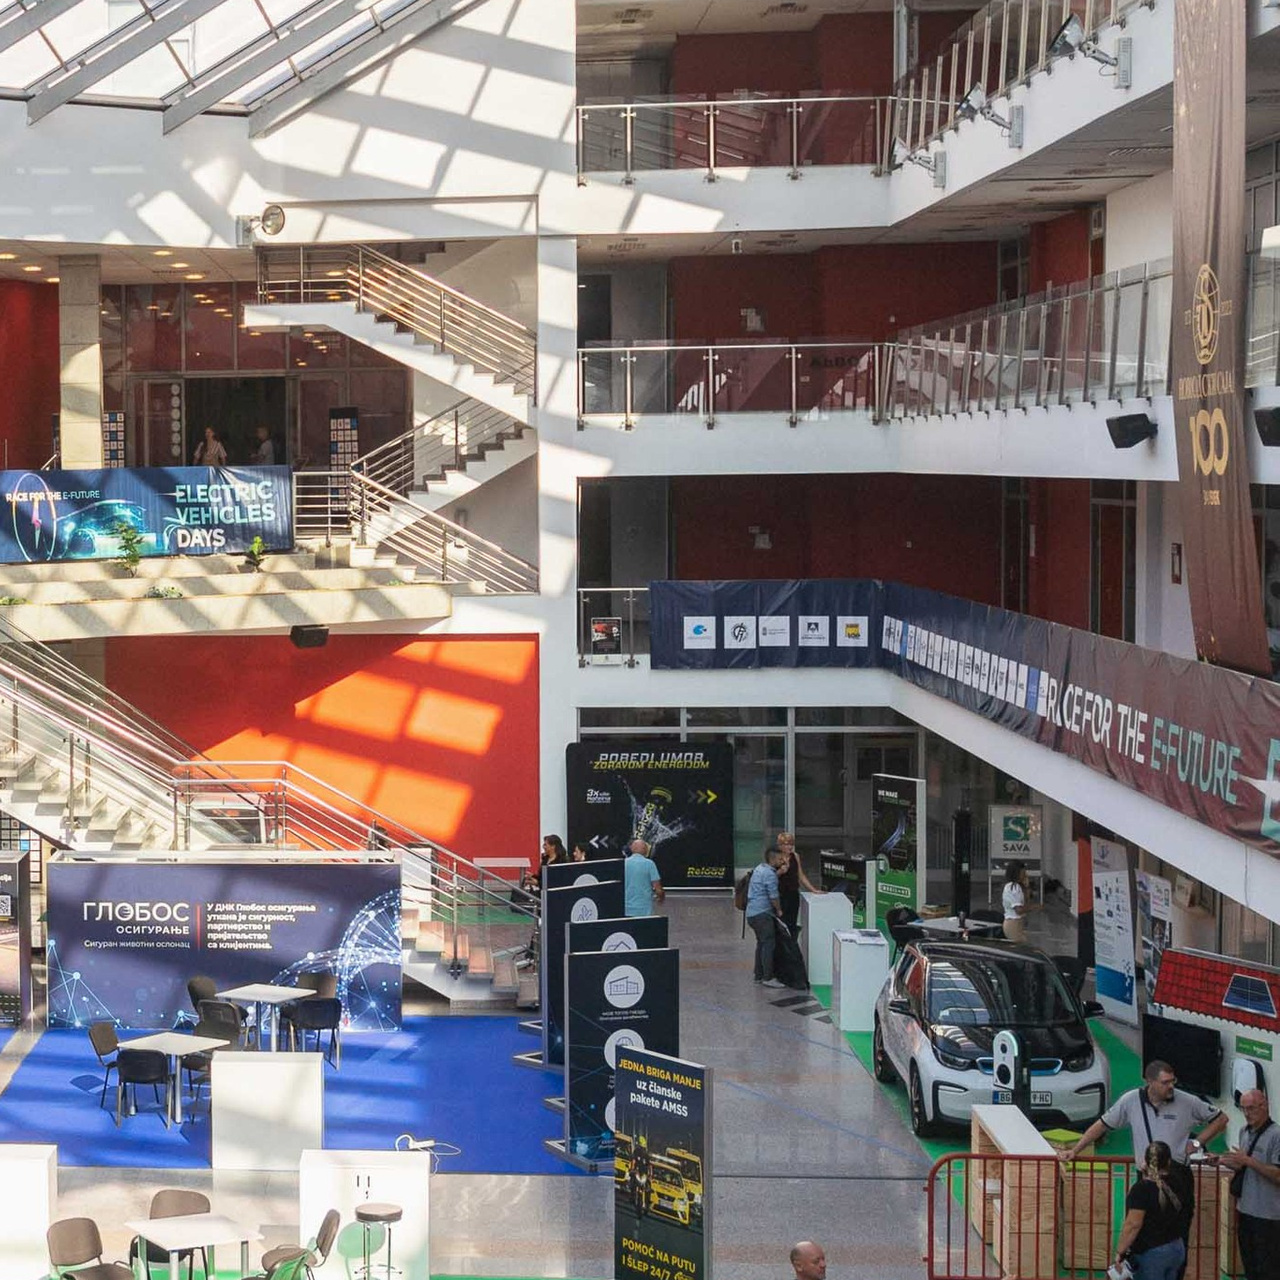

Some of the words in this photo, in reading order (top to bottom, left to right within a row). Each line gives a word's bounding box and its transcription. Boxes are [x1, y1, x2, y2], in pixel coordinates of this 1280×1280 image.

[1189, 407, 1229, 476] 100
[6, 491, 29, 502] RACE
[29, 491, 47, 501] FOR
[46, 491, 62, 501] THE
[62, 490, 100, 500] E-FUTURE
[176, 481, 273, 503] ELECTRIC
[177, 503, 276, 525] VEHICLES
[177, 528, 226, 549] DAYS
[1082, 690, 1113, 749] FOR
[1117, 703, 1148, 764] THE
[1151, 716, 1242, 805] E-FUTURE
[1002, 843, 1031, 853] SAVA
[687, 867, 726, 876] Reload
[83, 902, 190, 921] ГЛОБОС
[207, 903, 214, 911] У
[215, 903, 235, 912] ДНК
[236, 903, 267, 912] Глобос
[207, 914, 237, 922] уткана
[238, 913, 247, 922] је
[248, 914, 296, 923] сигурност,
[207, 923, 264, 932] партнерство
[116, 925, 190, 935] ОСИГУРАЊЕ
[207, 932, 268, 941] пријатељство
[84, 939, 118, 949] Сигуран
[156, 941, 191, 949] ослонац
[619, 1058, 645, 1073] JEDNA
[646, 1066, 671, 1081] BRIGA
[673, 1073, 702, 1090] MANJE
[636, 1080, 647, 1091] uz
[648, 1081, 682, 1100] članske
[630, 1092, 660, 1108] pakete
[662, 1100, 688, 1117] AMSS
[622, 1237, 655, 1258] POMOĆ
[656, 1250, 669, 1264] NA
[671, 1255, 696, 1273] PUTU
[627, 1254, 649, 1272] ŠLEP
[650, 1265, 671, 1280] 24/7
